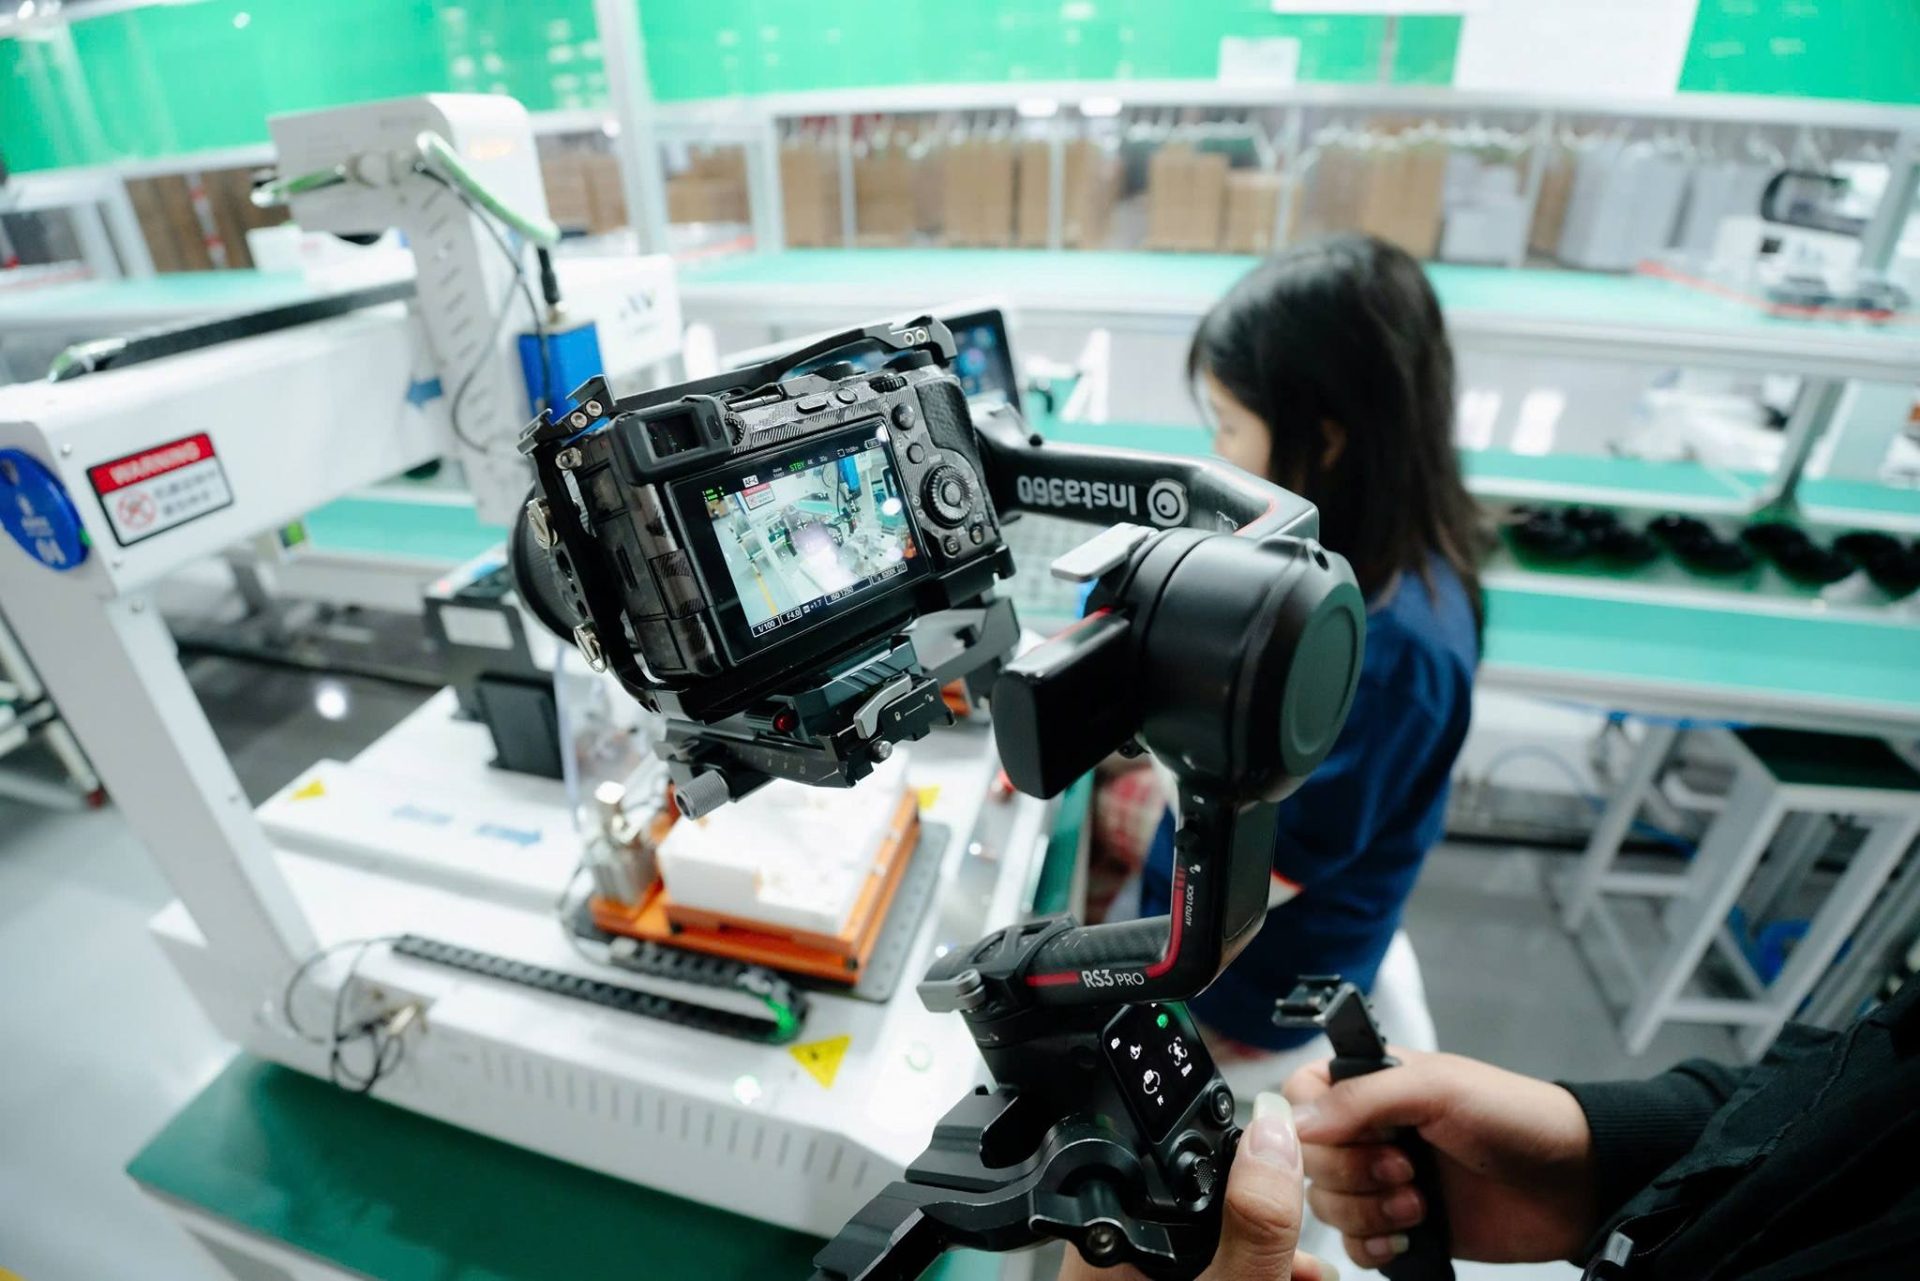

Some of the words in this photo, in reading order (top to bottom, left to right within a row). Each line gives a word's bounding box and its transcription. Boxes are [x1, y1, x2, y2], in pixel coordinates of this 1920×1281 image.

[789, 462, 806, 472] STBY
[1017, 475, 1138, 516] Insta360
[758, 621, 775, 632] 1/100
[786, 610, 800, 620] F4.0
[830, 592, 840, 600] ISO
[1186, 885, 1194, 905] LOCK
[1185, 906, 1193, 927] AUTO
[1081, 969, 1114, 988] RS3
[1115, 972, 1145, 986] PRO
